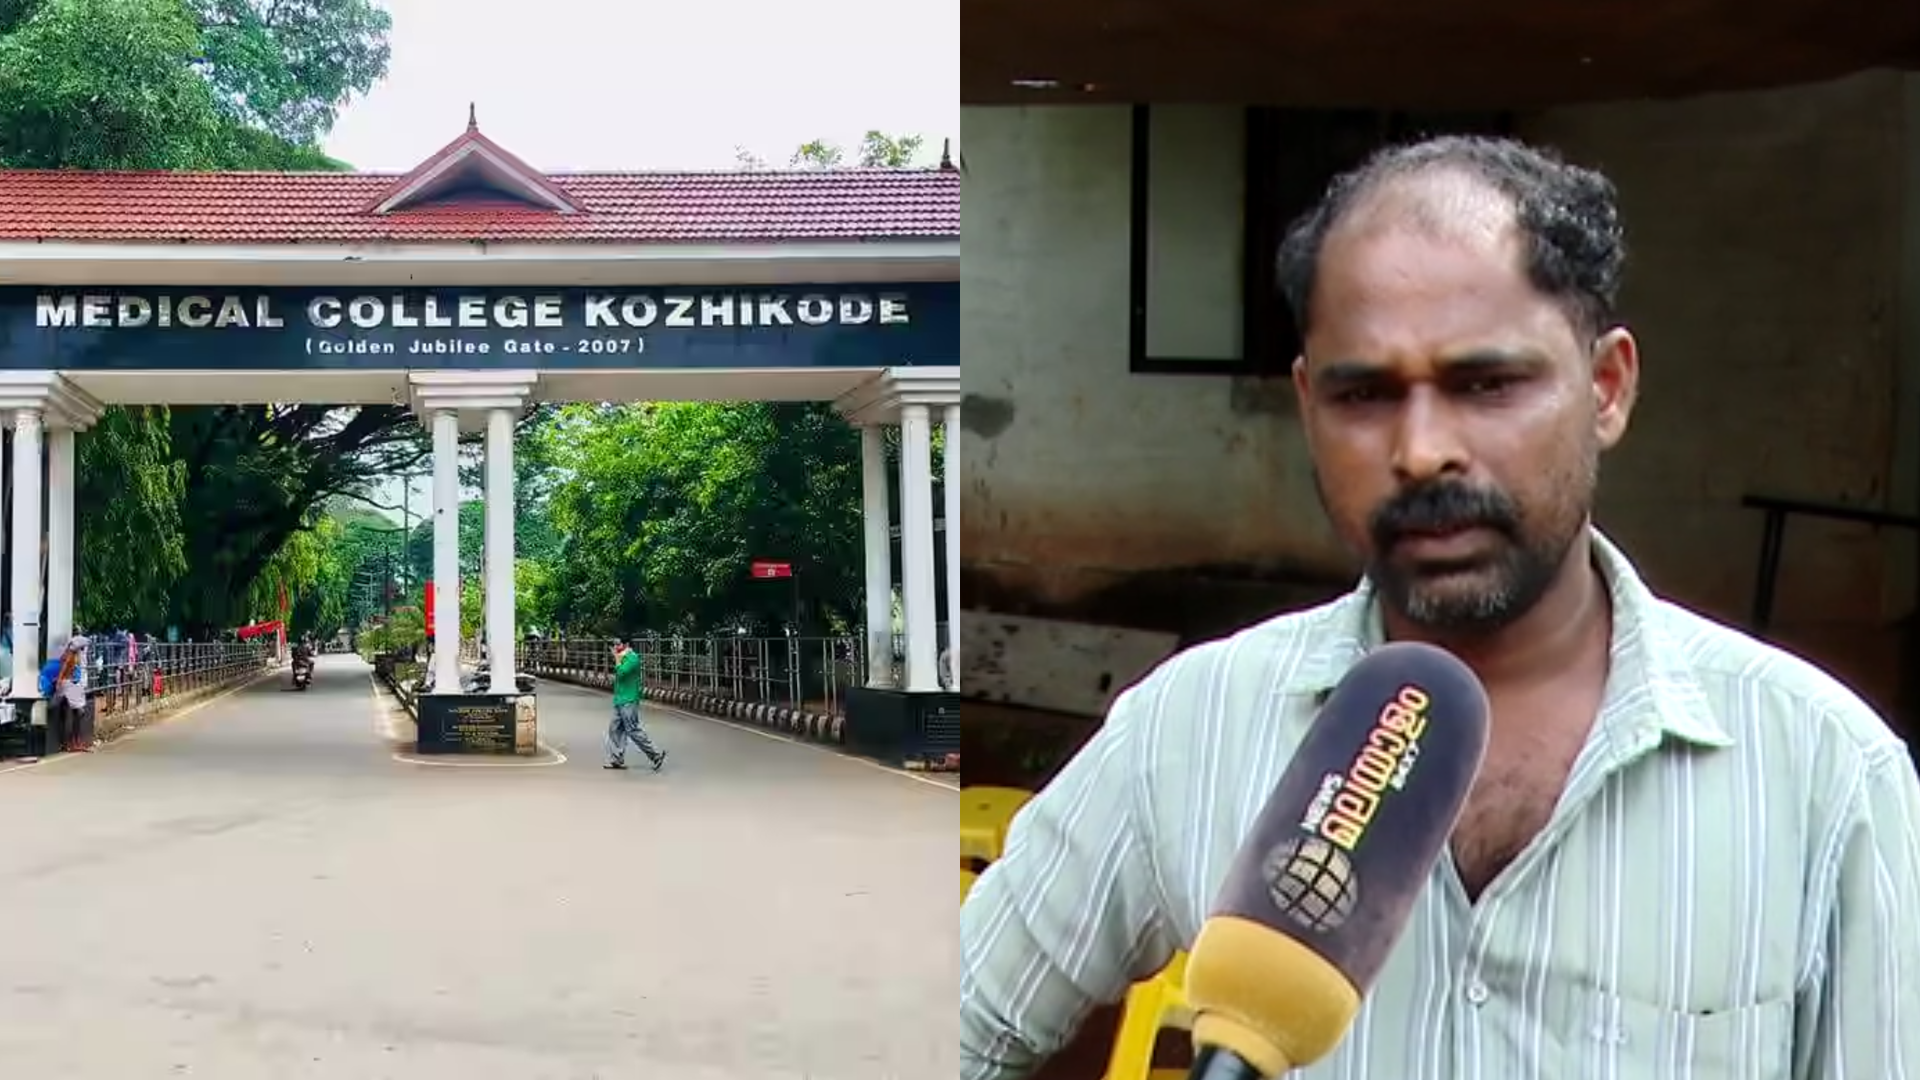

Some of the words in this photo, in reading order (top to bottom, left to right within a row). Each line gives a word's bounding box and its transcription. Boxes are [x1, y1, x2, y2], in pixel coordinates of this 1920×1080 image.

[35, 295, 285, 328] MEDICAL
[307, 295, 564, 328] COLLEGE
[584, 294, 910, 328] KOZHIKODE
[408, 338, 491, 355] Jubilee
[1320, 686, 1428, 850] മലയാളം
[1300, 773, 1343, 832] NEWS
